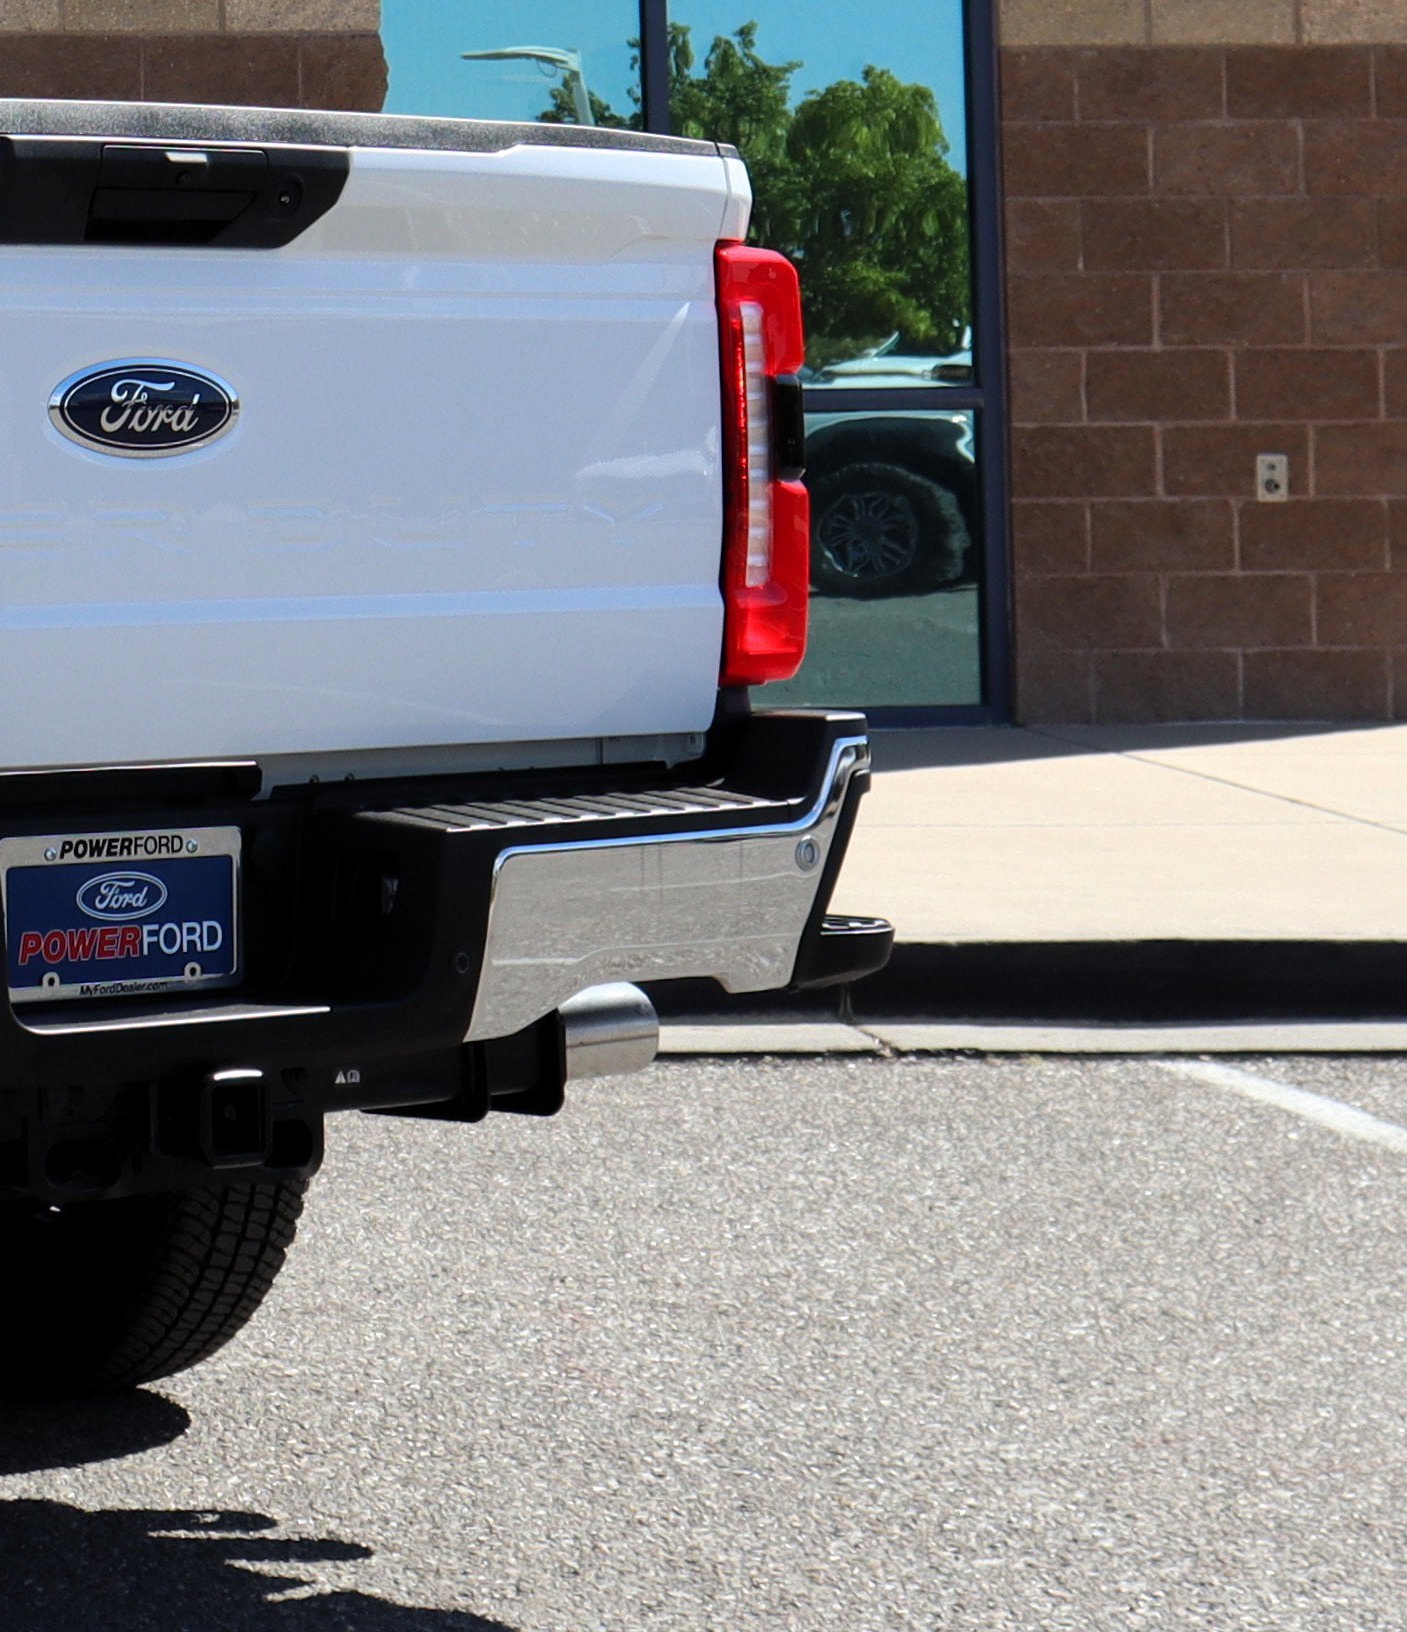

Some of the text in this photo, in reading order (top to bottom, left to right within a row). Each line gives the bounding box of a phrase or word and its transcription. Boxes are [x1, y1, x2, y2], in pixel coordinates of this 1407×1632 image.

[99, 378, 201, 434] Ford
[246, 494, 670, 556] DUTY
[59, 834, 183, 859] POWERFORD
[94, 880, 149, 909] Ford
[18, 920, 223, 965] POWERFORD
[79, 980, 168, 996] MyFordDealer.com
